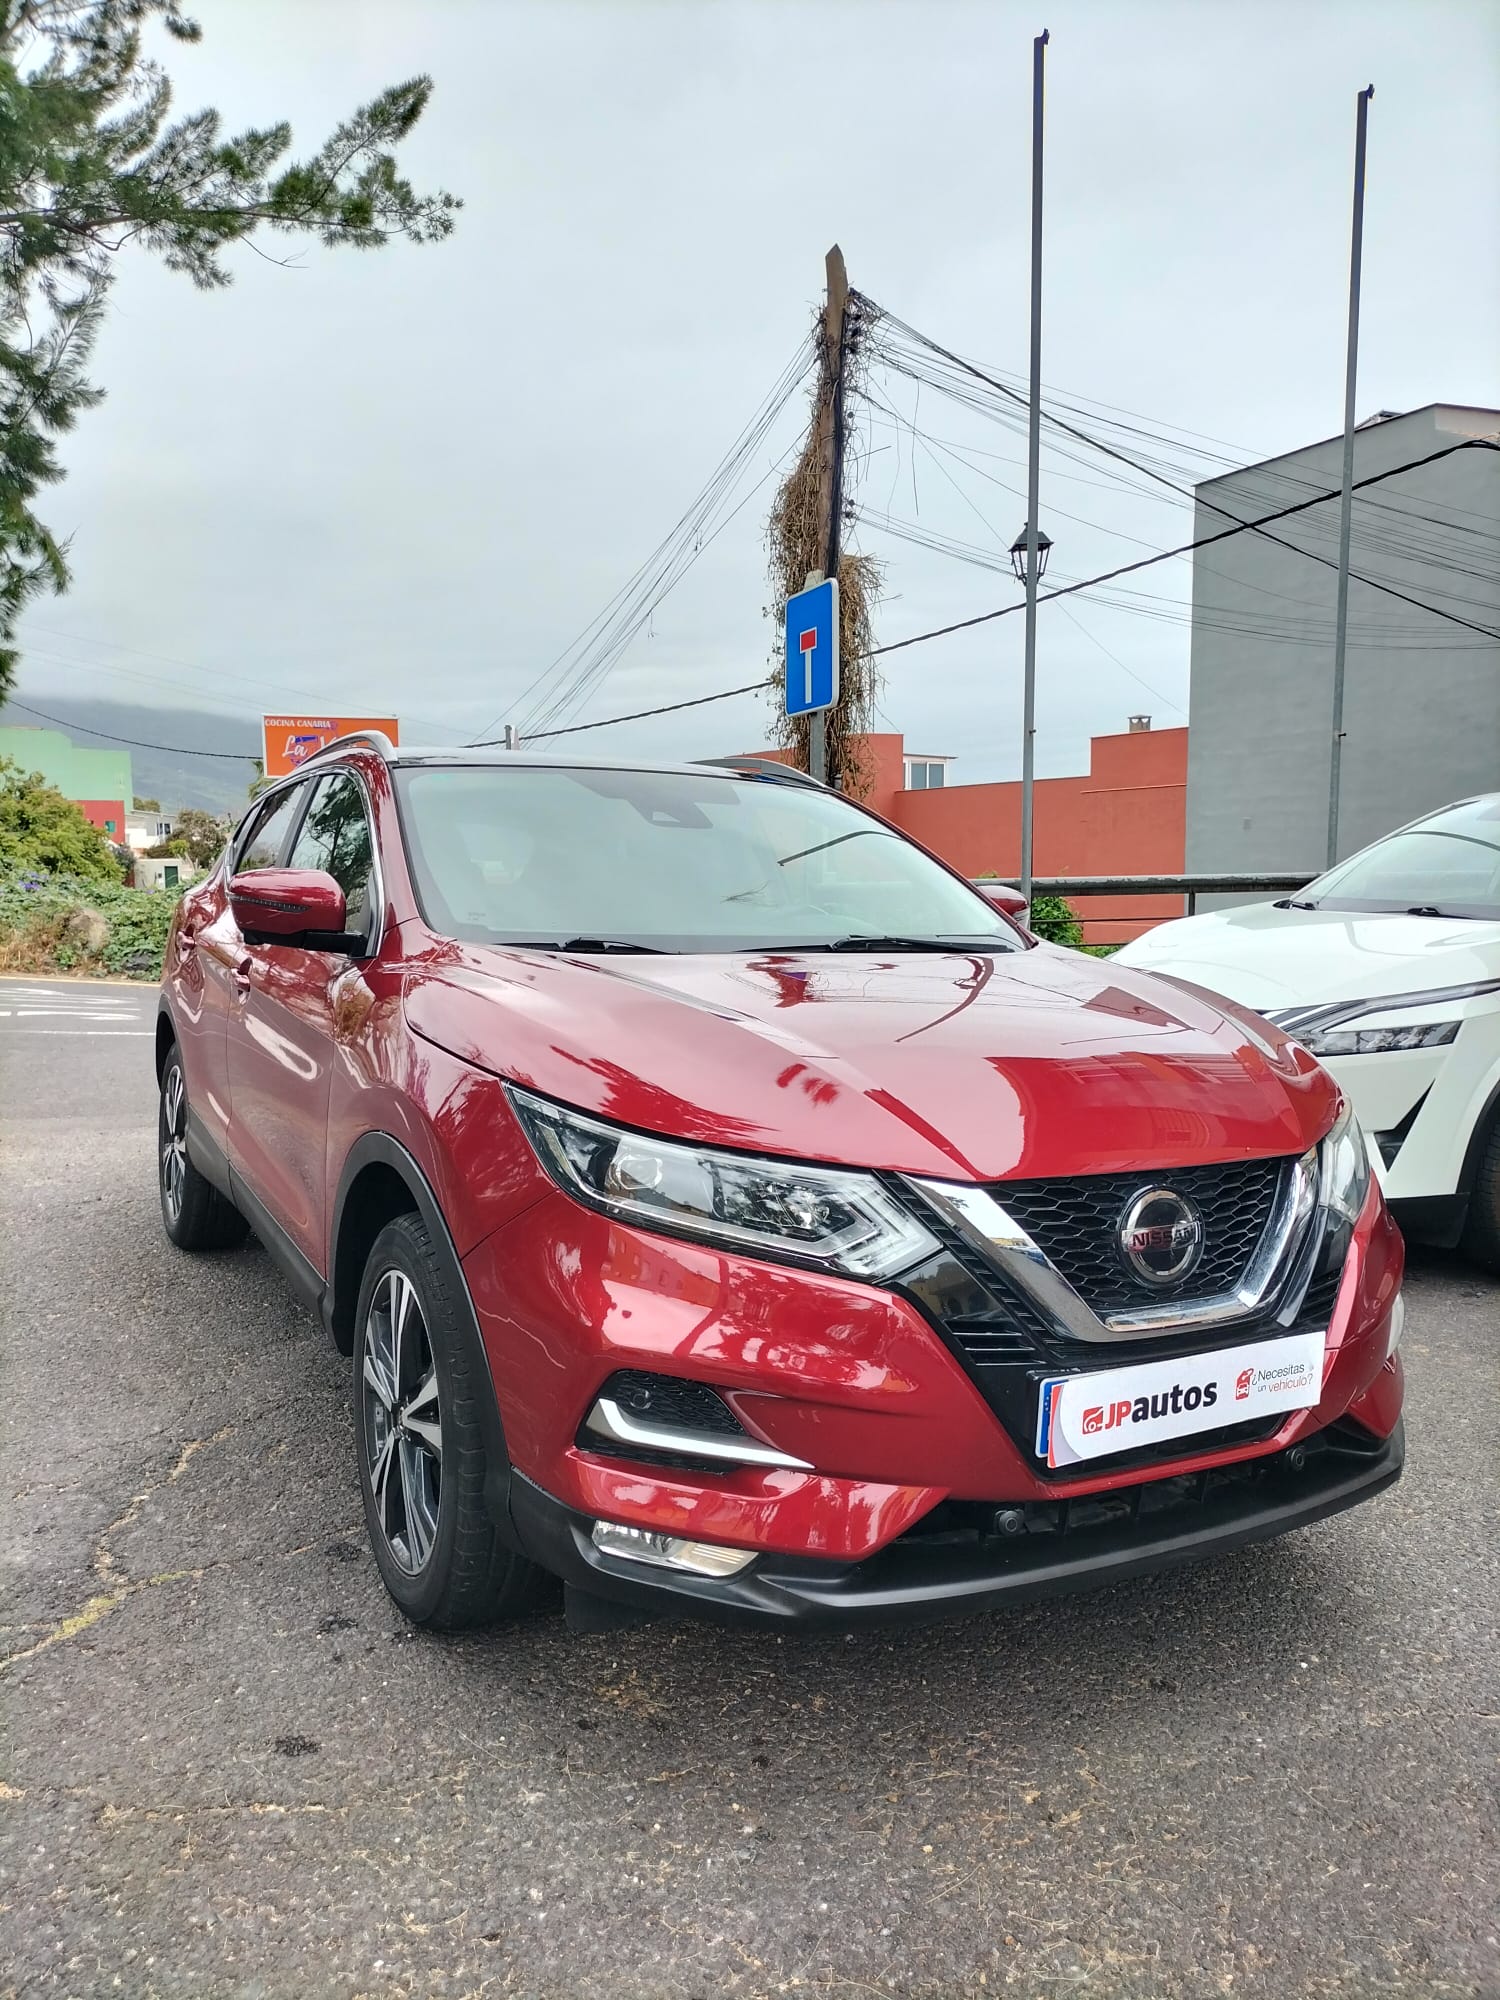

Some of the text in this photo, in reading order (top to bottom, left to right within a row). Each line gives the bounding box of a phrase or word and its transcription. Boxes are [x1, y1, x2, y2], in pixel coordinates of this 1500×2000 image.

[265, 719, 331, 728] COCINA CANARIA
[282, 735, 308, 757] La
[1132, 1225, 1193, 1247] NISSAN
[1251, 1362, 1305, 1386] ¿Necesitas
[1257, 1372, 1314, 1393] un vehículo?
[1104, 1381, 1218, 1430] JPautos
